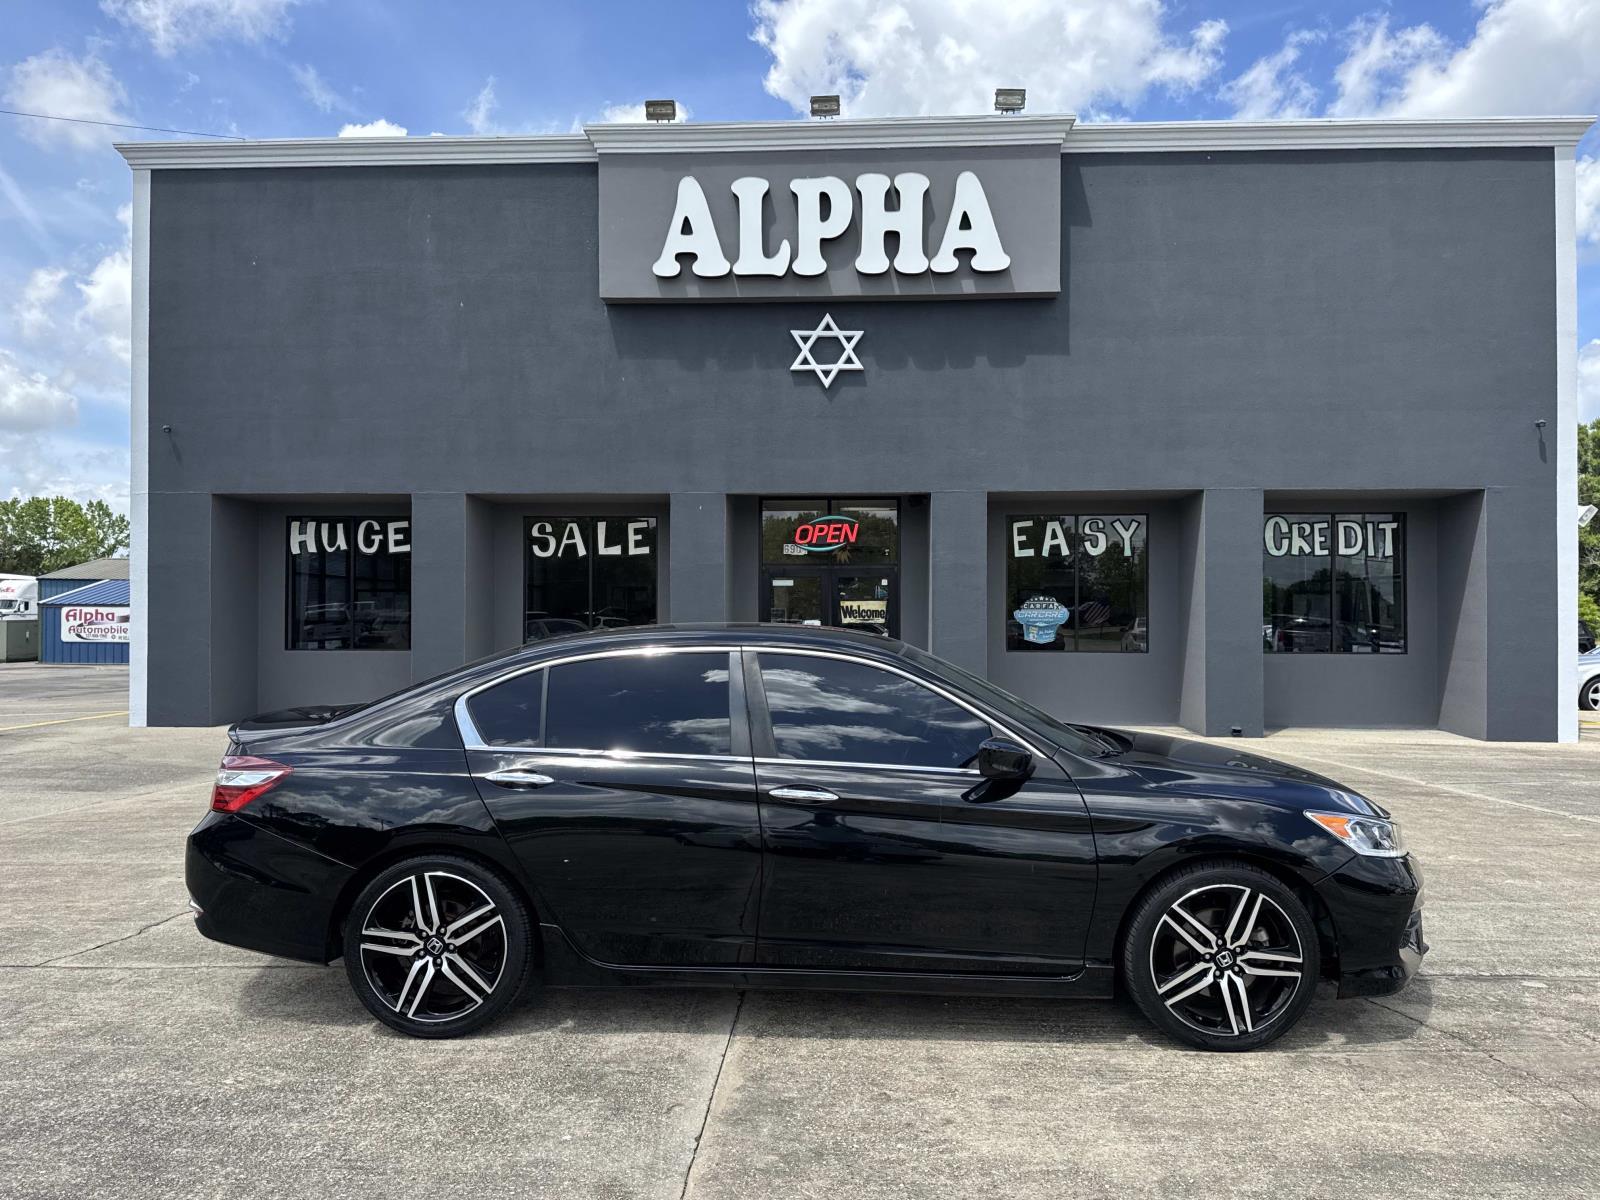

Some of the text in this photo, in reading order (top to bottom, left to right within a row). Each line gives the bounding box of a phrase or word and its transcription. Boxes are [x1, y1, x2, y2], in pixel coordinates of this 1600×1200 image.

[652, 171, 1011, 278] ALPHA
[289, 519, 411, 555] HUGE
[531, 517, 650, 558] SALE
[795, 523, 859, 544] OPEN
[1012, 518, 1141, 558] EASY
[1264, 515, 1398, 557] CREDIT
[65, 608, 115, 625] Alpha
[840, 605, 886, 619] Welcome
